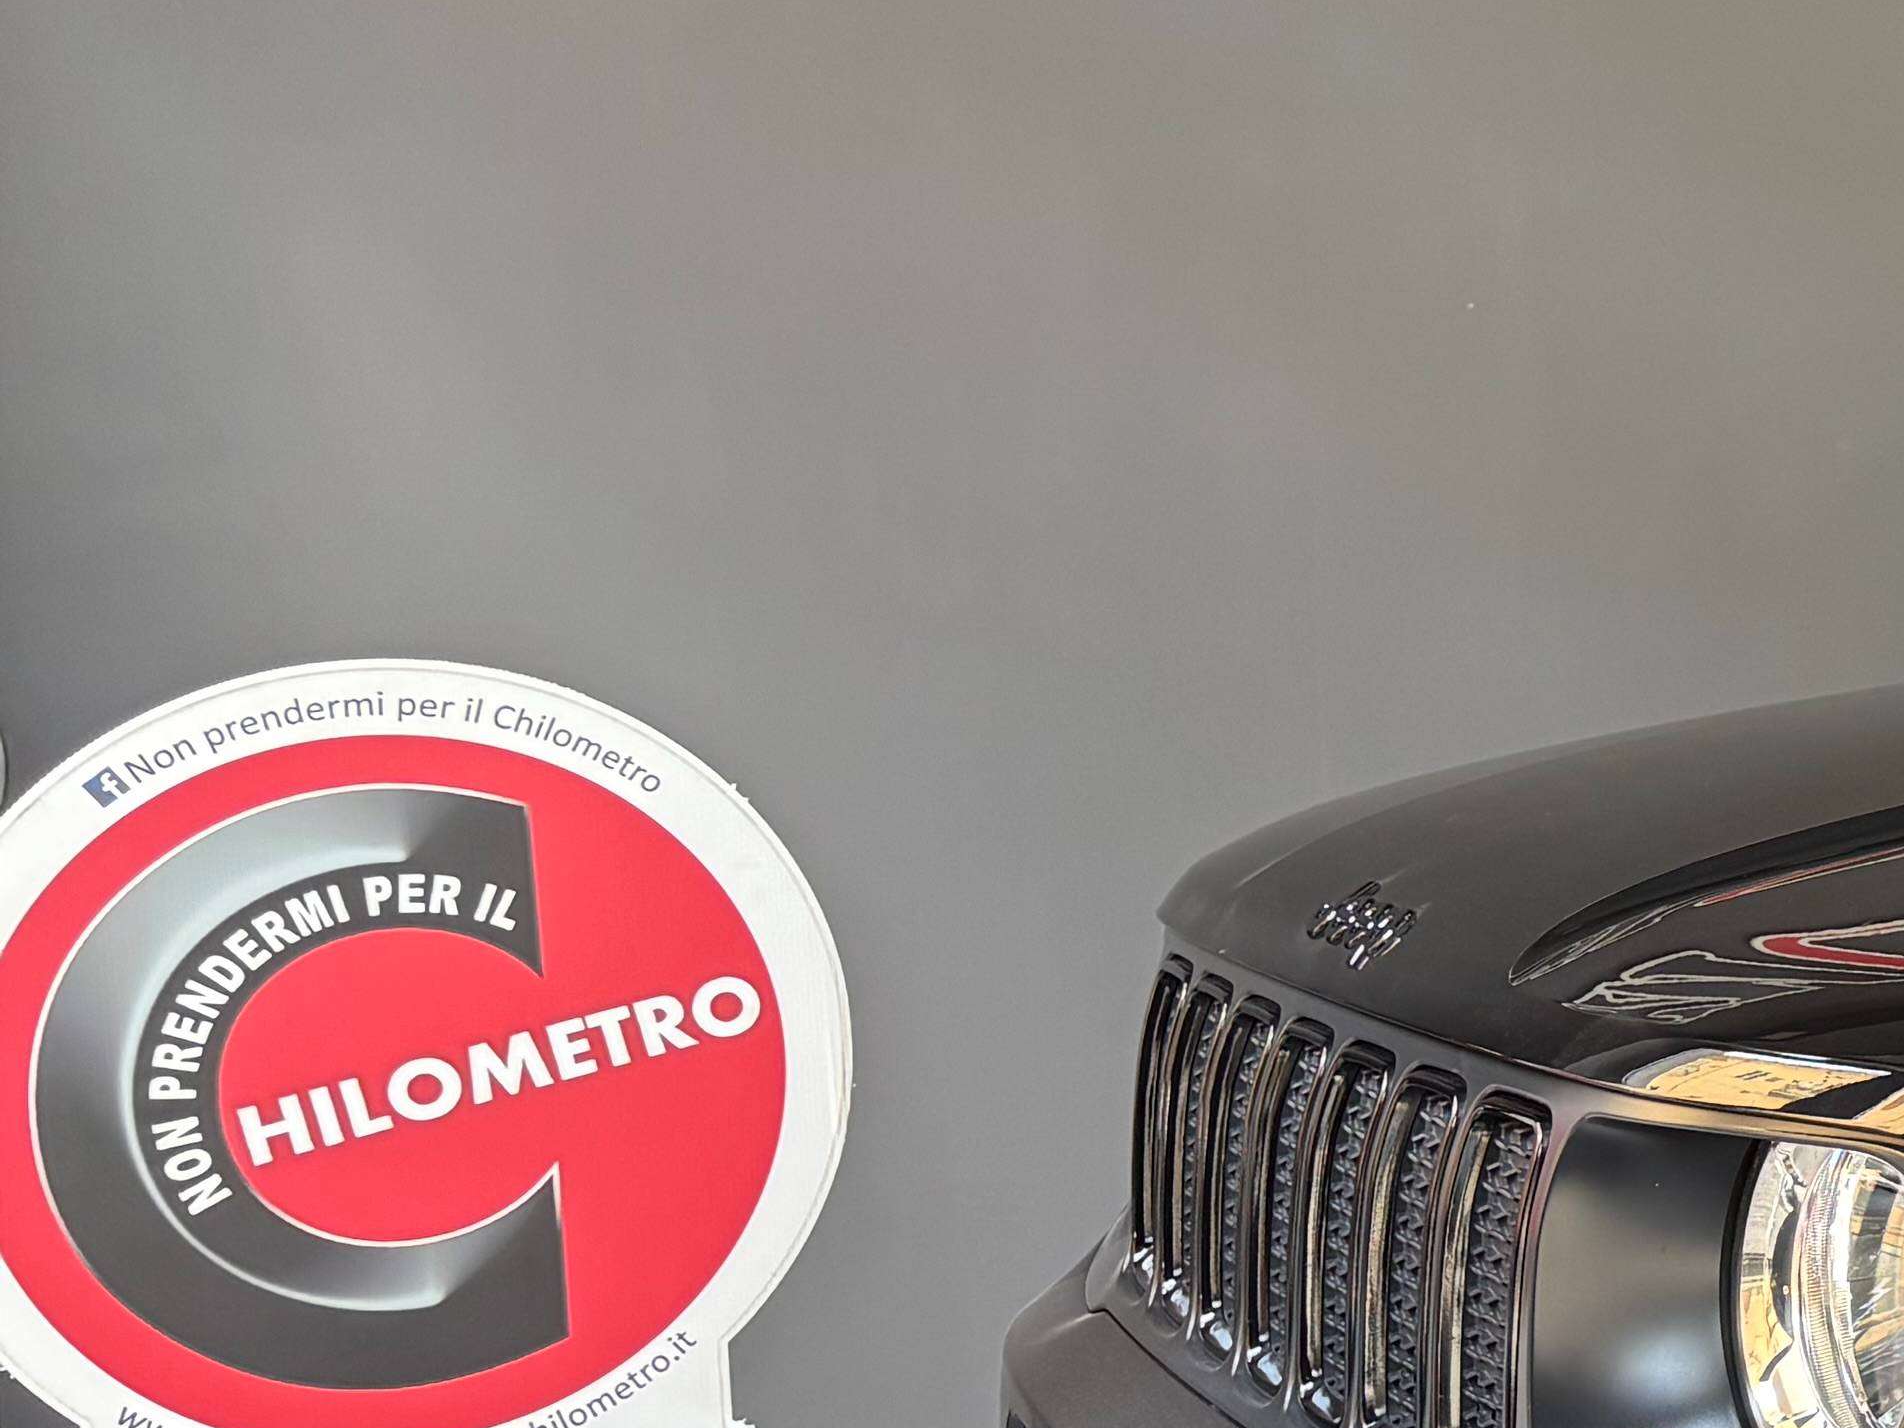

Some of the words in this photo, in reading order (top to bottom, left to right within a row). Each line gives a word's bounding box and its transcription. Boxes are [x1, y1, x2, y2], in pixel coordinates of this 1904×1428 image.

[125, 736, 197, 784] Non
[203, 690, 385, 751] prendermi
[398, 694, 455, 721] per
[465, 695, 484, 721] il
[493, 703, 663, 795] Chilometro
[363, 873, 460, 916] PER
[474, 882, 518, 932] IL
[149, 884, 350, 1101] PRENDERMI
[152, 1121, 231, 1217] NON
